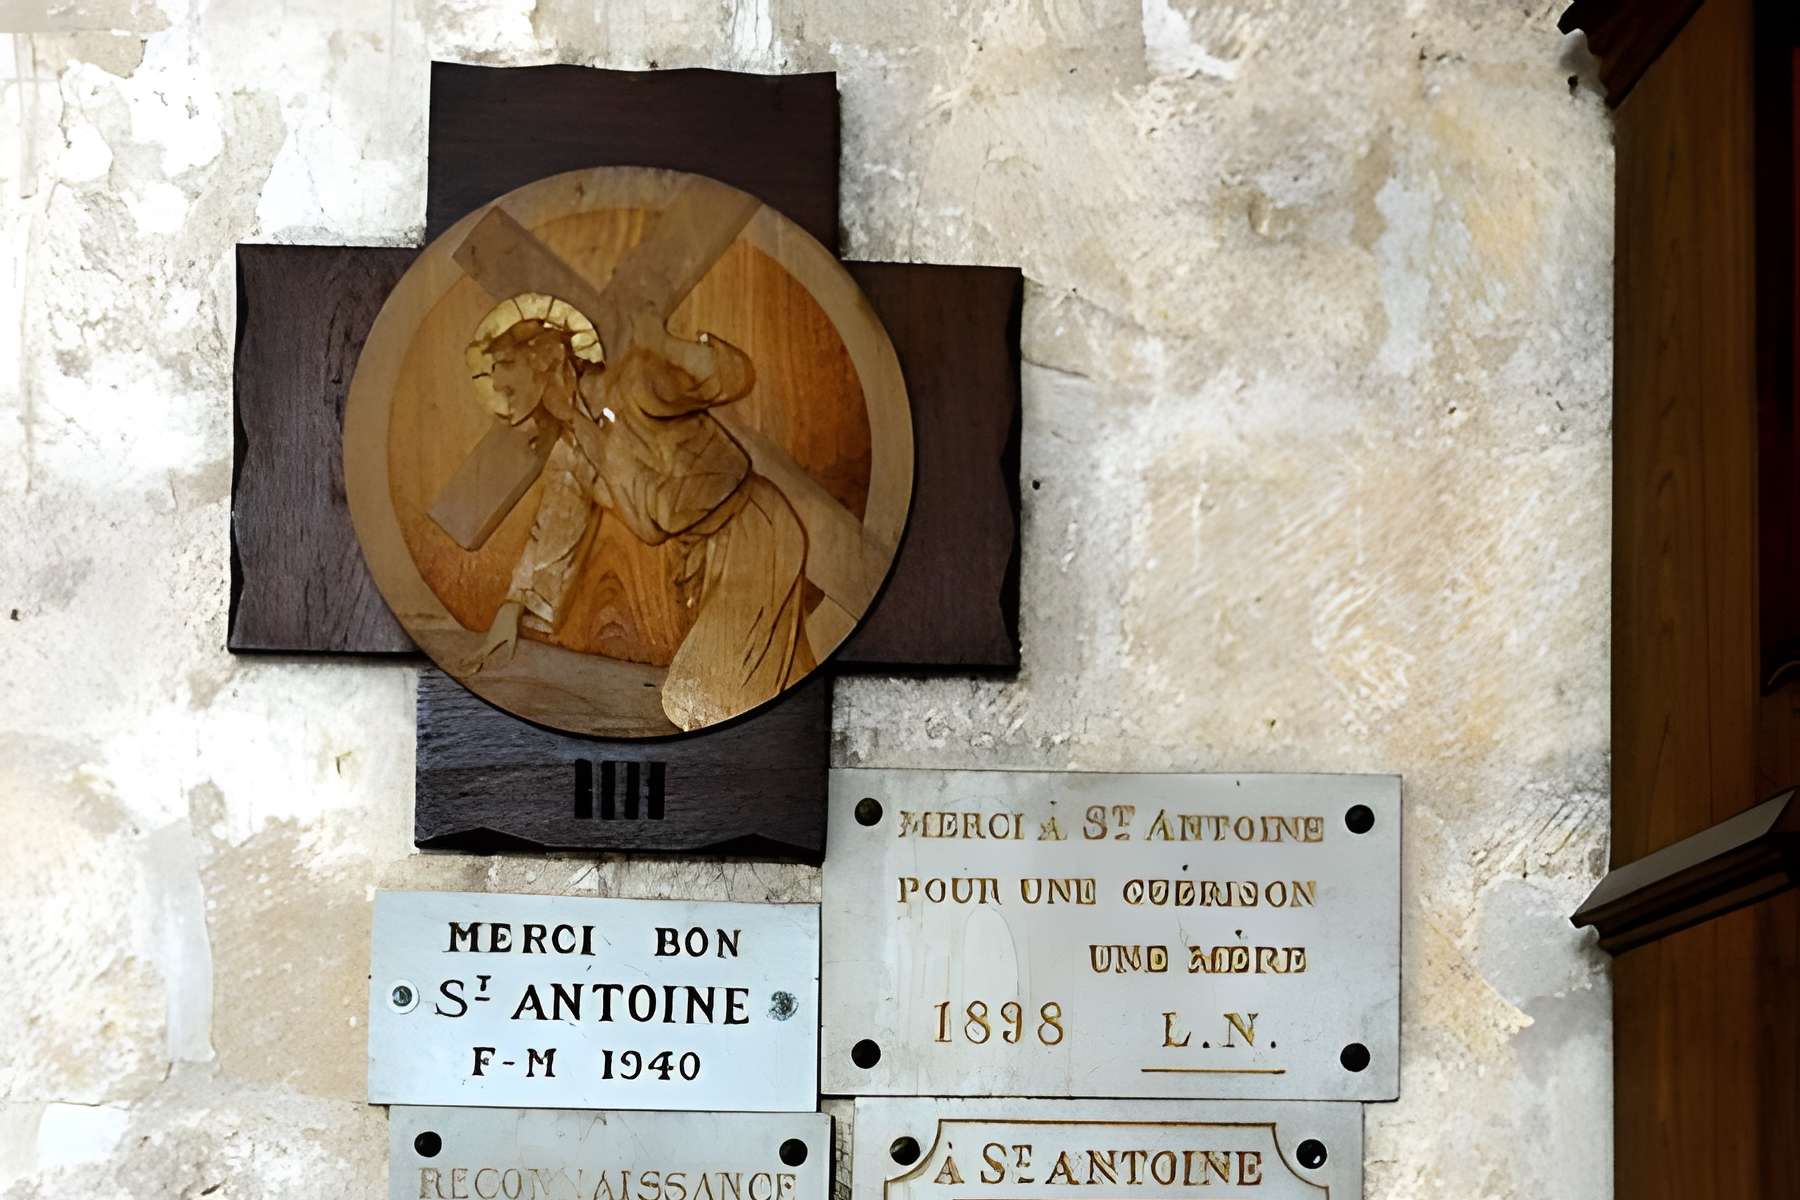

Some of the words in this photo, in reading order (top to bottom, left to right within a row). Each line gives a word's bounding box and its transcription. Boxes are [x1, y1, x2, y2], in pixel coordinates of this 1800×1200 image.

[898, 811, 1026, 840] MERCI
[1145, 809, 1324, 843] ANTOINE
[897, 877, 1002, 904] POUR
[1020, 878, 1097, 905] UNE
[443, 921, 596, 956] MERCI
[655, 927, 741, 959] BON
[1089, 945, 1168, 973] UNE
[511, 983, 750, 1025] ANTOINE
[934, 1001, 1064, 1046] 1898
[601, 1049, 701, 1081] 1940
[1045, 1150, 1263, 1186] ANTOINE
